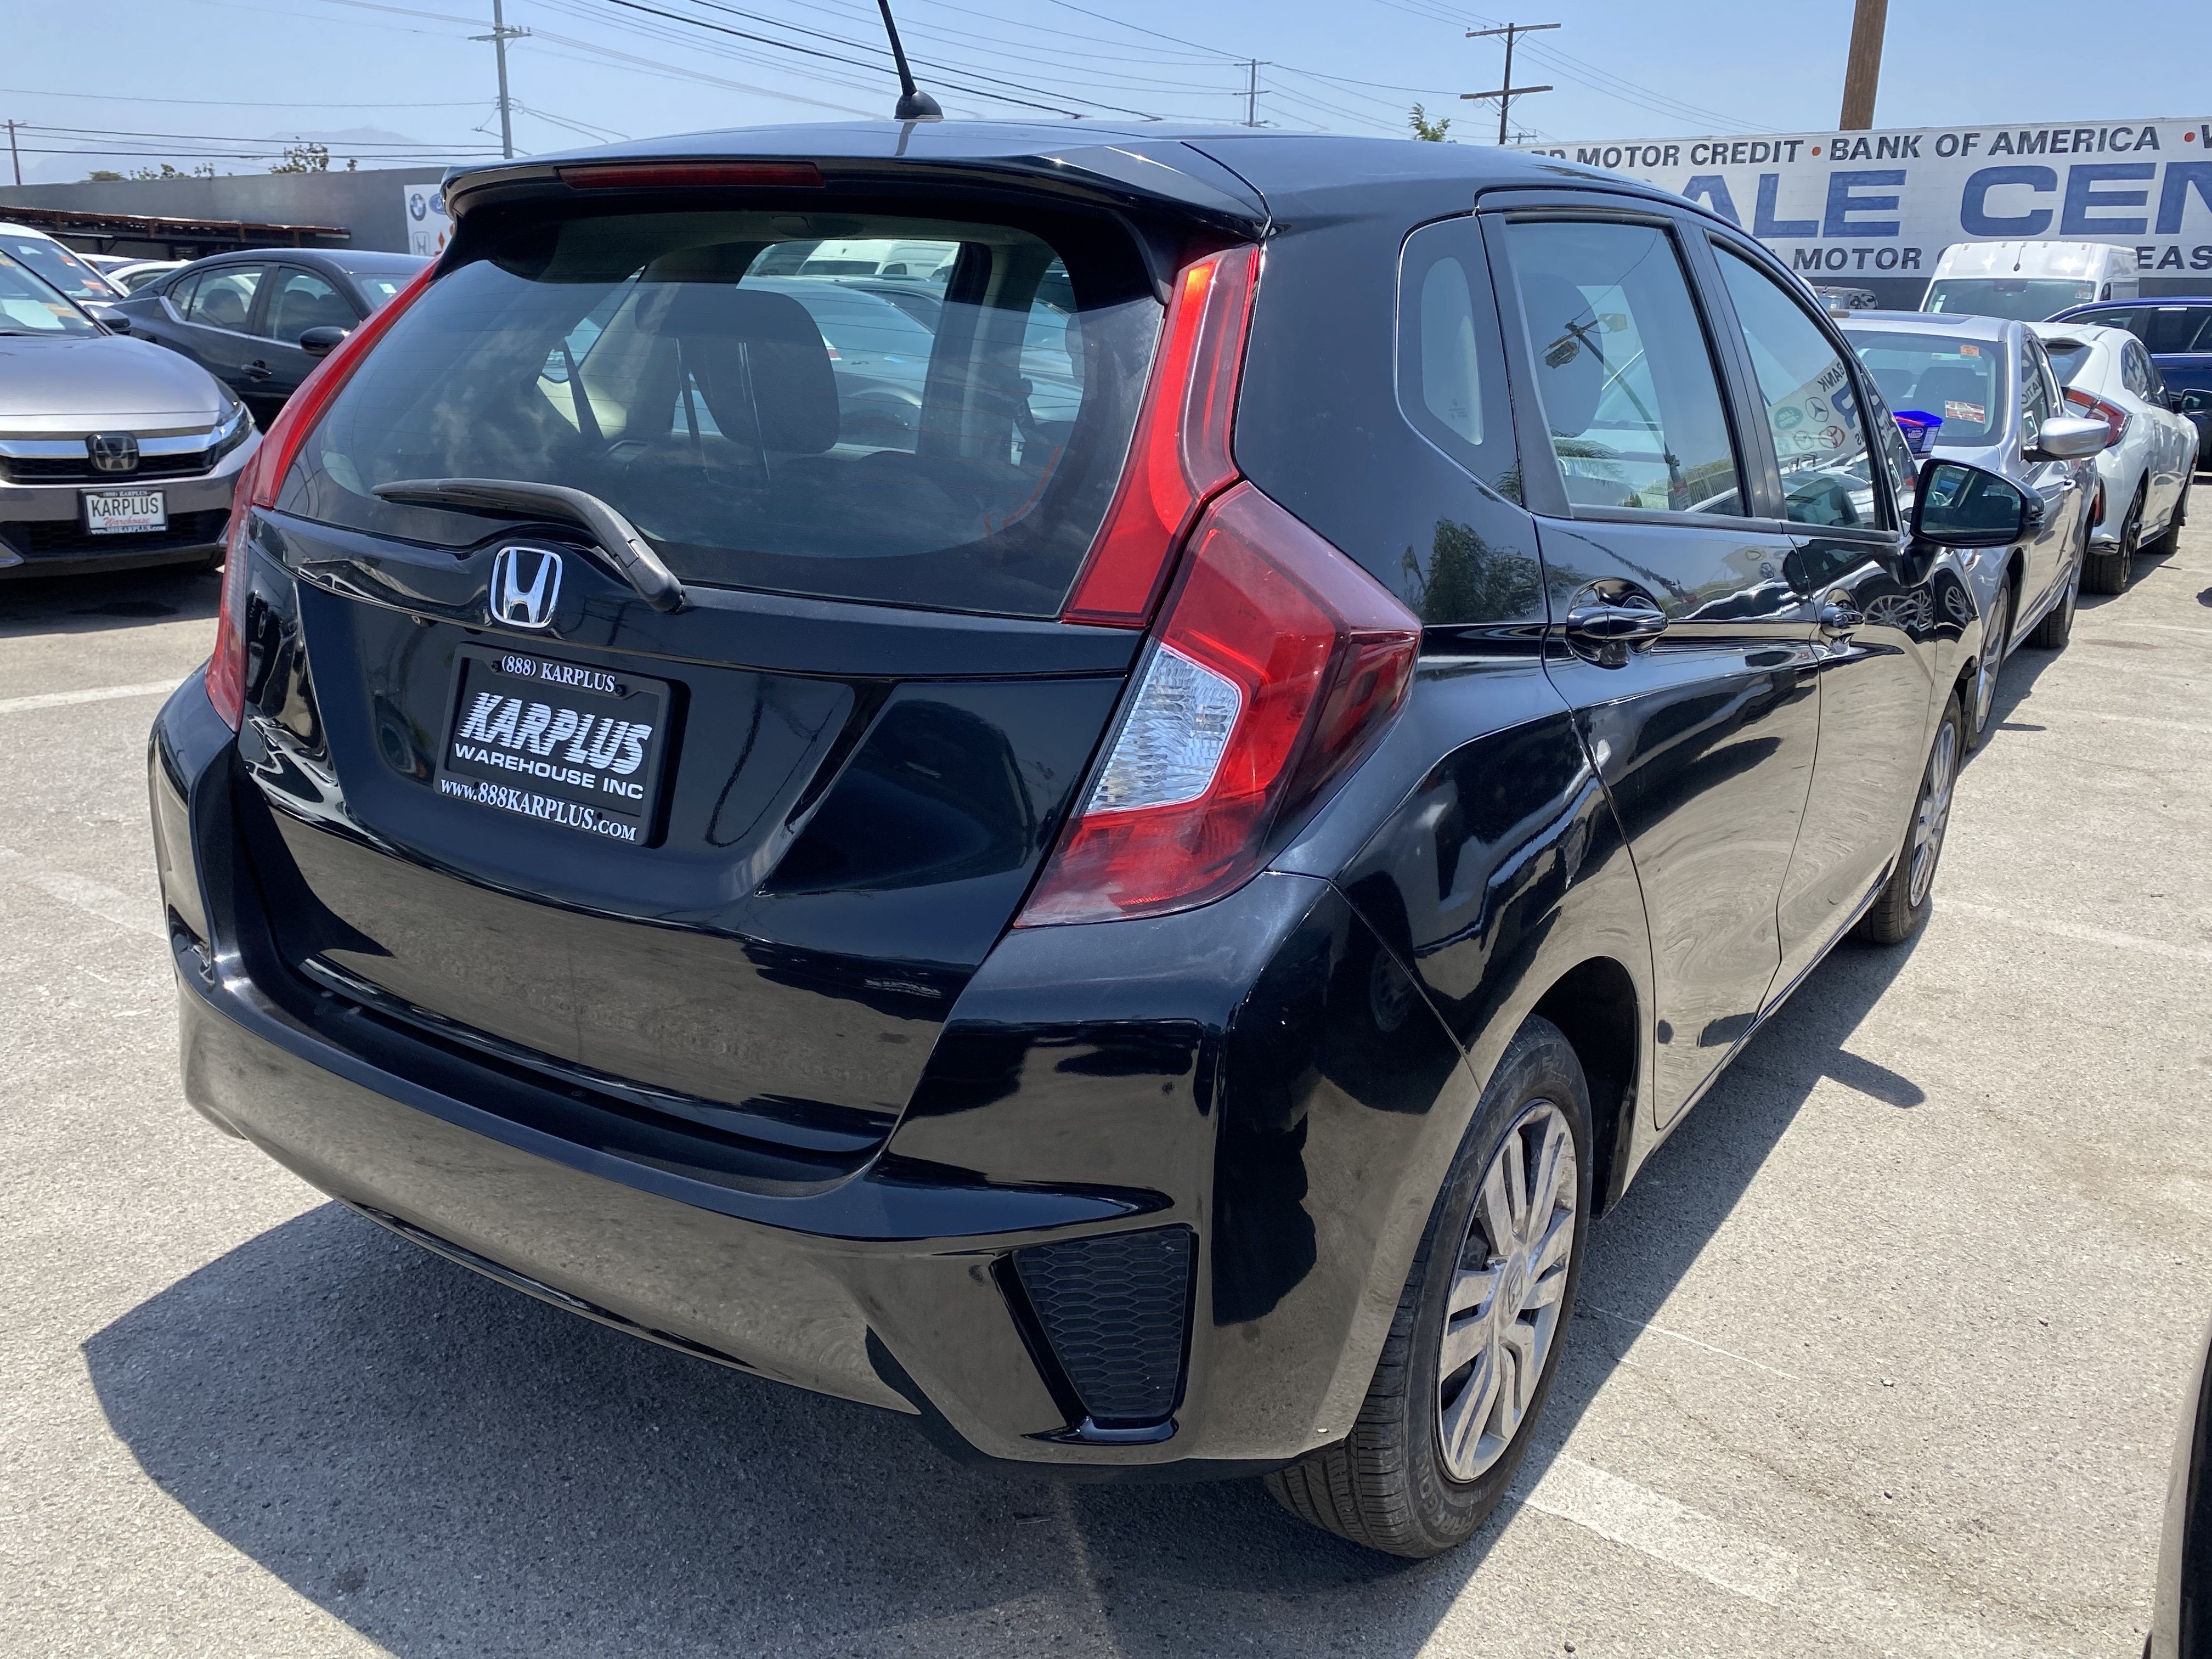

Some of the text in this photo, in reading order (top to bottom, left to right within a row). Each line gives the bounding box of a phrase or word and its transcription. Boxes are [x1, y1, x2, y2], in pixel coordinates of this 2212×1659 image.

[1577, 126, 2160, 168] MOTOR CREDIT BANK OF AMERICA
[1792, 247, 1922, 270] MOTOR
[91, 497, 159, 517] KARPLUS
[103, 516, 150, 526] Warehouse
[501, 655, 615, 692] (888) KARPLUS
[458, 692, 653, 775] KARPLUS
[455, 743, 644, 799] WAREHOUSE INC
